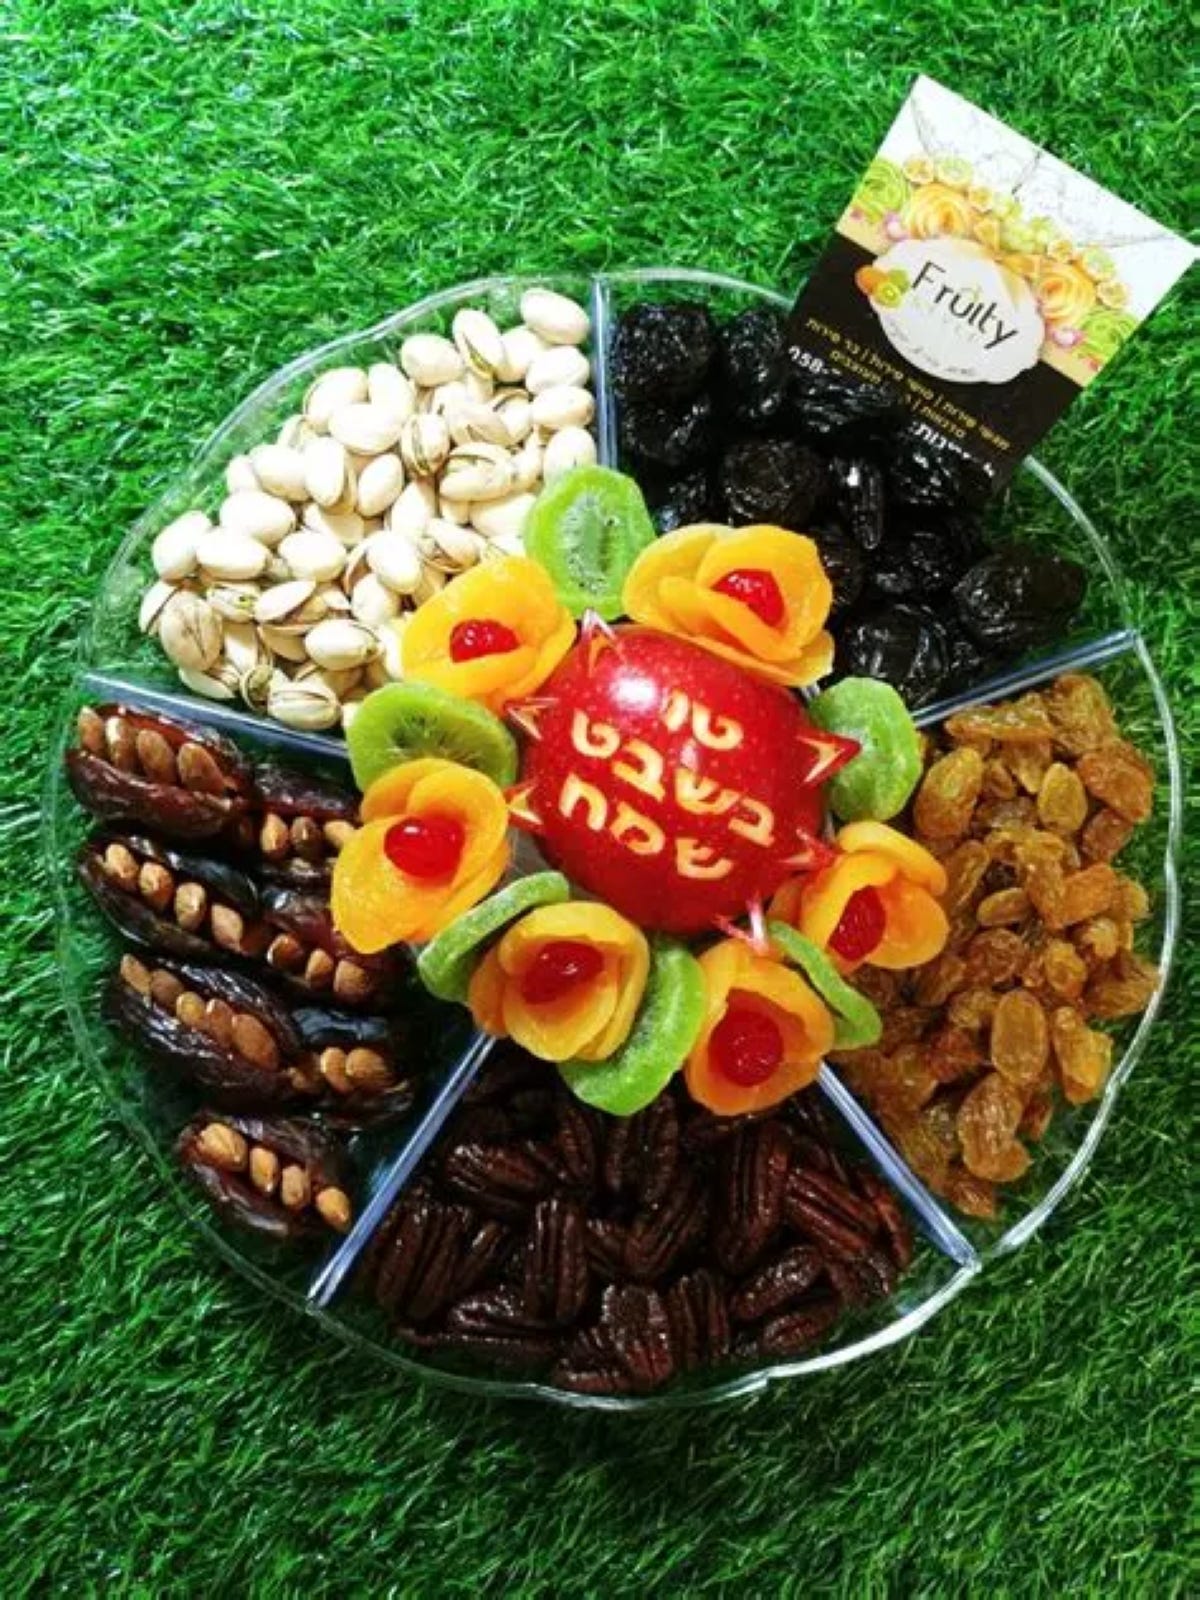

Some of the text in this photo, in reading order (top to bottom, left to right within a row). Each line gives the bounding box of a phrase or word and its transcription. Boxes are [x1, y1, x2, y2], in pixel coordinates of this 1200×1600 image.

[911, 260, 1018, 350] Fruity
[559, 773, 734, 879] שמח
[572, 709, 775, 847] בשבט
